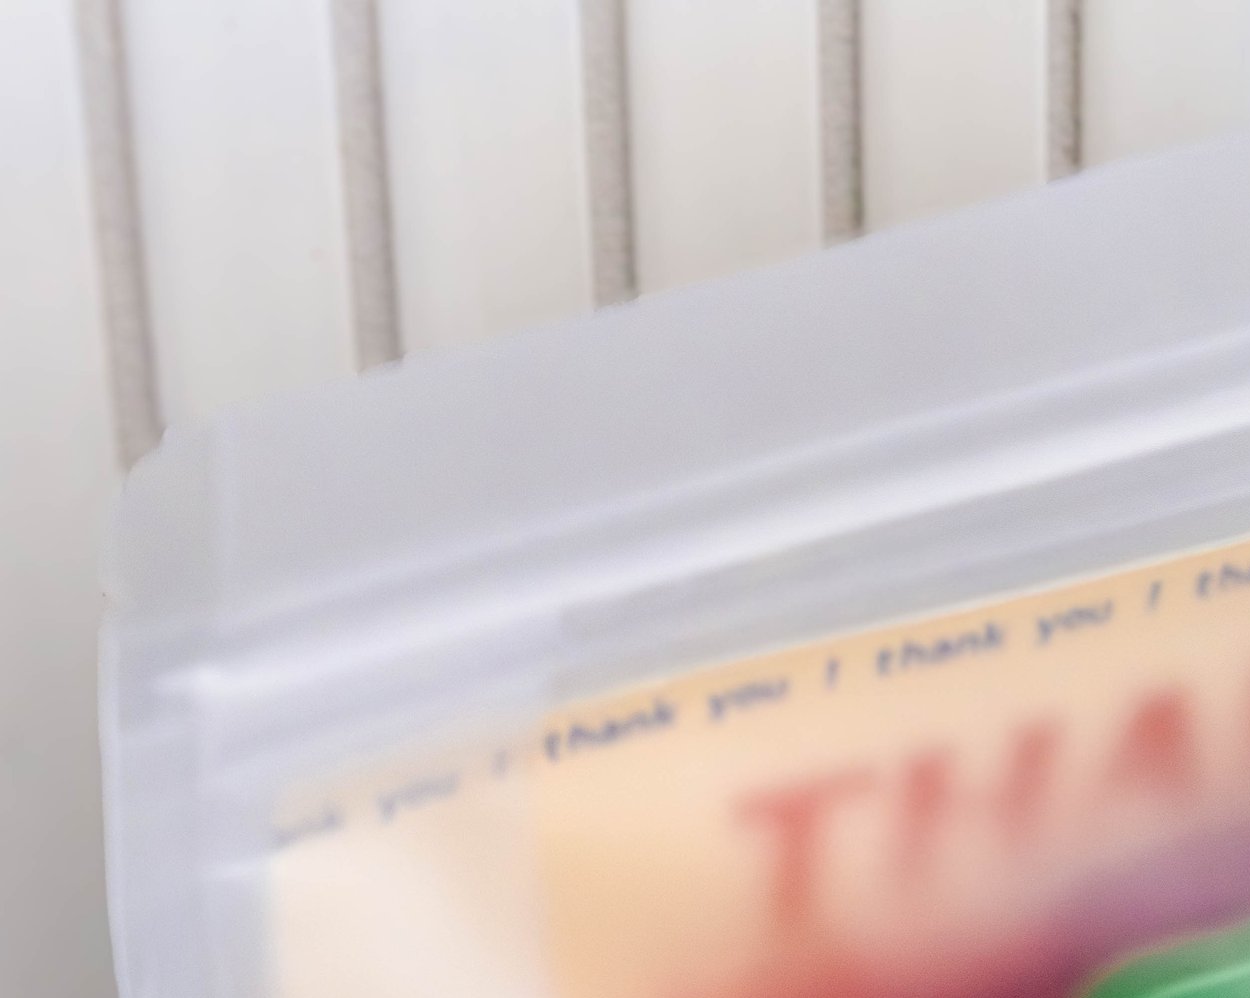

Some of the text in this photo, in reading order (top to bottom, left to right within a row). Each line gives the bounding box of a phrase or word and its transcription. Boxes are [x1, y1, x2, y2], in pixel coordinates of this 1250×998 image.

[544, 698, 676, 761] thank
[707, 679, 790, 721] you
[875, 621, 1005, 676] thank
[1035, 599, 1113, 646] you
